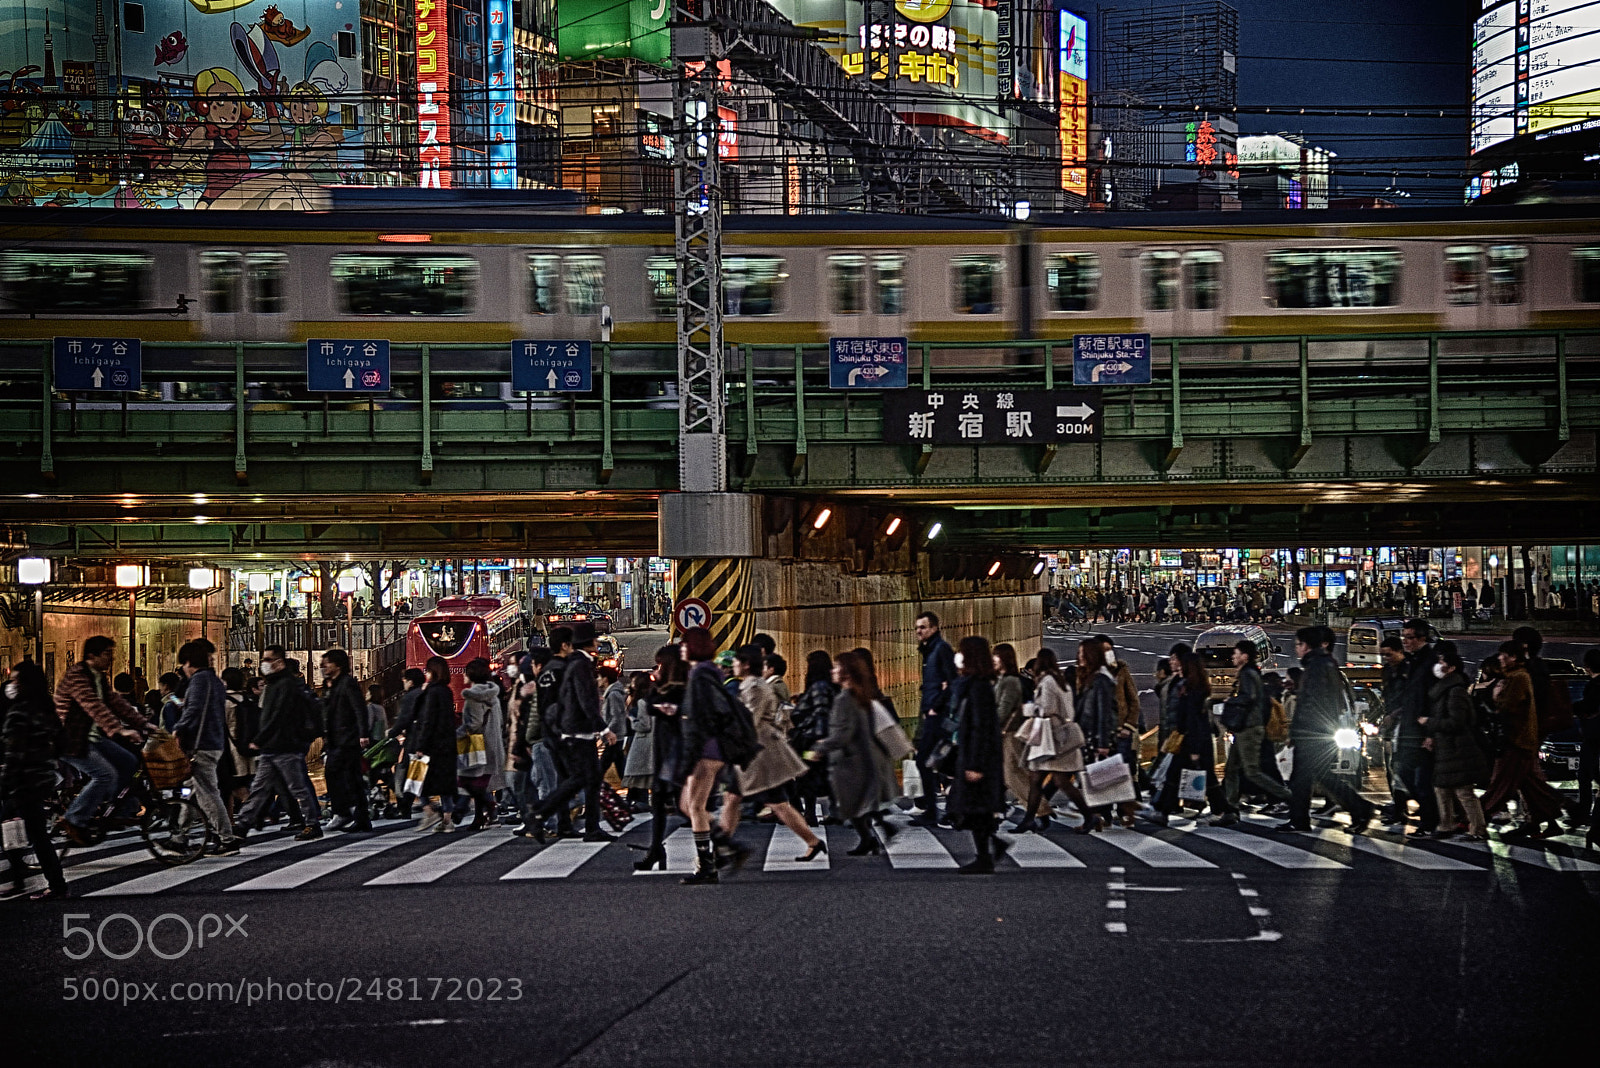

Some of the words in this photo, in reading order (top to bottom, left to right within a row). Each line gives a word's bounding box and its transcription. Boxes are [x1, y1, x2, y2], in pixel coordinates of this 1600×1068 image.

[835, 339, 902, 354] 新宿駅東口
[1078, 336, 1145, 350] 新宿駅東口
[838, 354, 871, 363] Shinjuku
[1081, 350, 1114, 360] Shinjuku
[74, 356, 121, 367] Ichigaya
[326, 358, 371, 368] Ichigaya
[530, 358, 573, 368] Ichigaya
[862, 366, 874, 376] 430
[1106, 363, 1118, 372] 430
[114, 374, 127, 383] 302
[364, 374, 377, 384] 302
[566, 374, 579, 384] 302
[927, 392, 1015, 410] 中央線
[908, 411, 1034, 439] 新宿駅
[1056, 423, 1094, 435] 300M
[1309, 588, 1316, 596] 6
